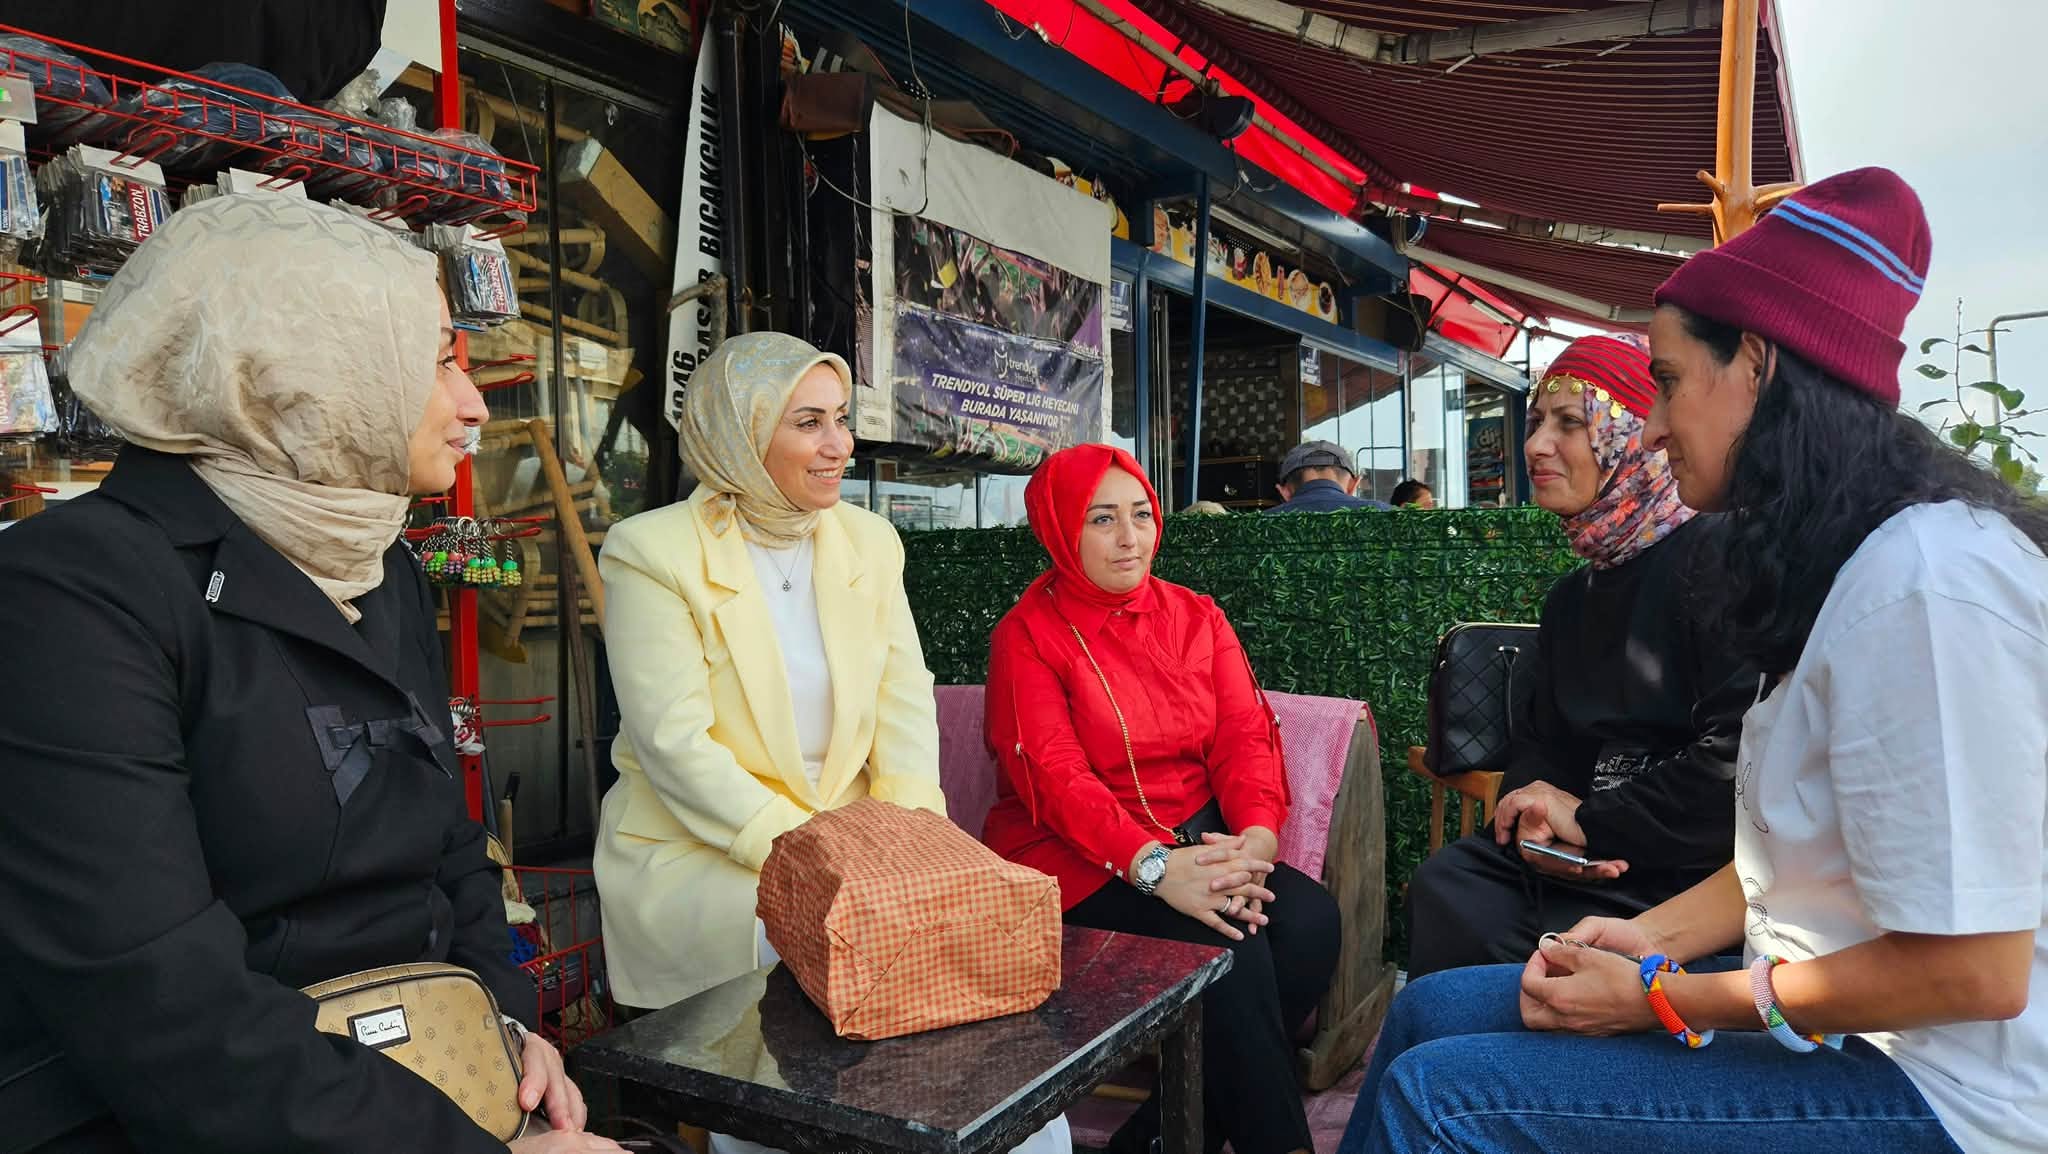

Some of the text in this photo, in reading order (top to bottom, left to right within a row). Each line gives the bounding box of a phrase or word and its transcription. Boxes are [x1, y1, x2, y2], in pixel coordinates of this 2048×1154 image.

[130, 187, 151, 239] TRABZON
[931, 373, 990, 398] TRENDYOL
[993, 384, 1025, 405] SÜPER
[1042, 397, 1079, 416] HEYECANI
[960, 398, 1059, 429] BURADA YAŞANIYOR
